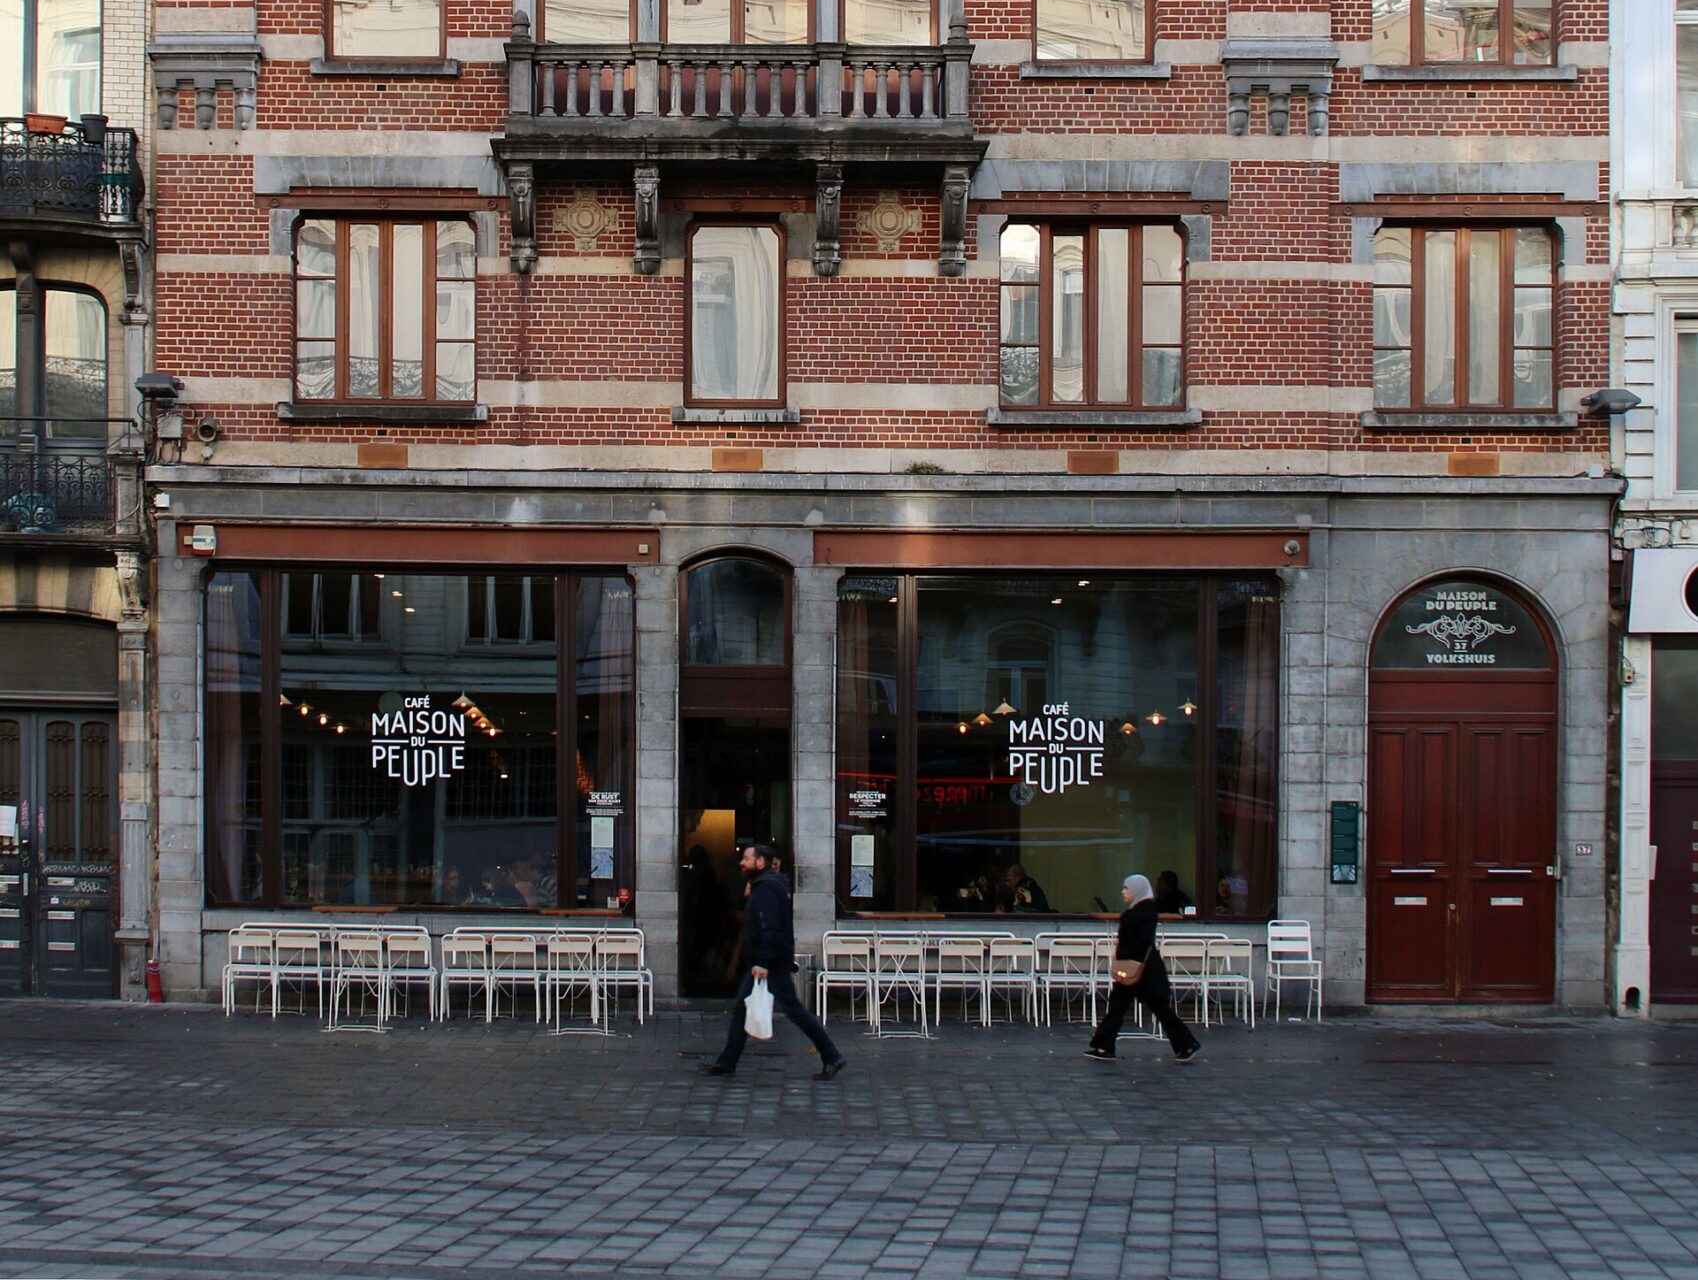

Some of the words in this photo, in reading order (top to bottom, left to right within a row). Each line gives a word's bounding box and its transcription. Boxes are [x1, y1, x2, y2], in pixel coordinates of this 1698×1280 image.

[1437, 592, 1486, 600] MAISON
[1426, 601, 1444, 610] DU
[1446, 601, 1497, 610] PEUPLE
[1454, 642, 1467, 650] 37
[1426, 654, 1496, 663] VOLKSHUIS
[404, 694, 430, 708] CAFÉ
[1043, 701, 1069, 715] CAFÉ
[372, 710, 465, 737] MAISON
[1009, 717, 1104, 744] MAISON
[410, 736, 426, 747] DU
[1048, 743, 1064, 754] DU
[372, 745, 465, 787] PEUPLE
[1009, 752, 1104, 794] PEUPLE
